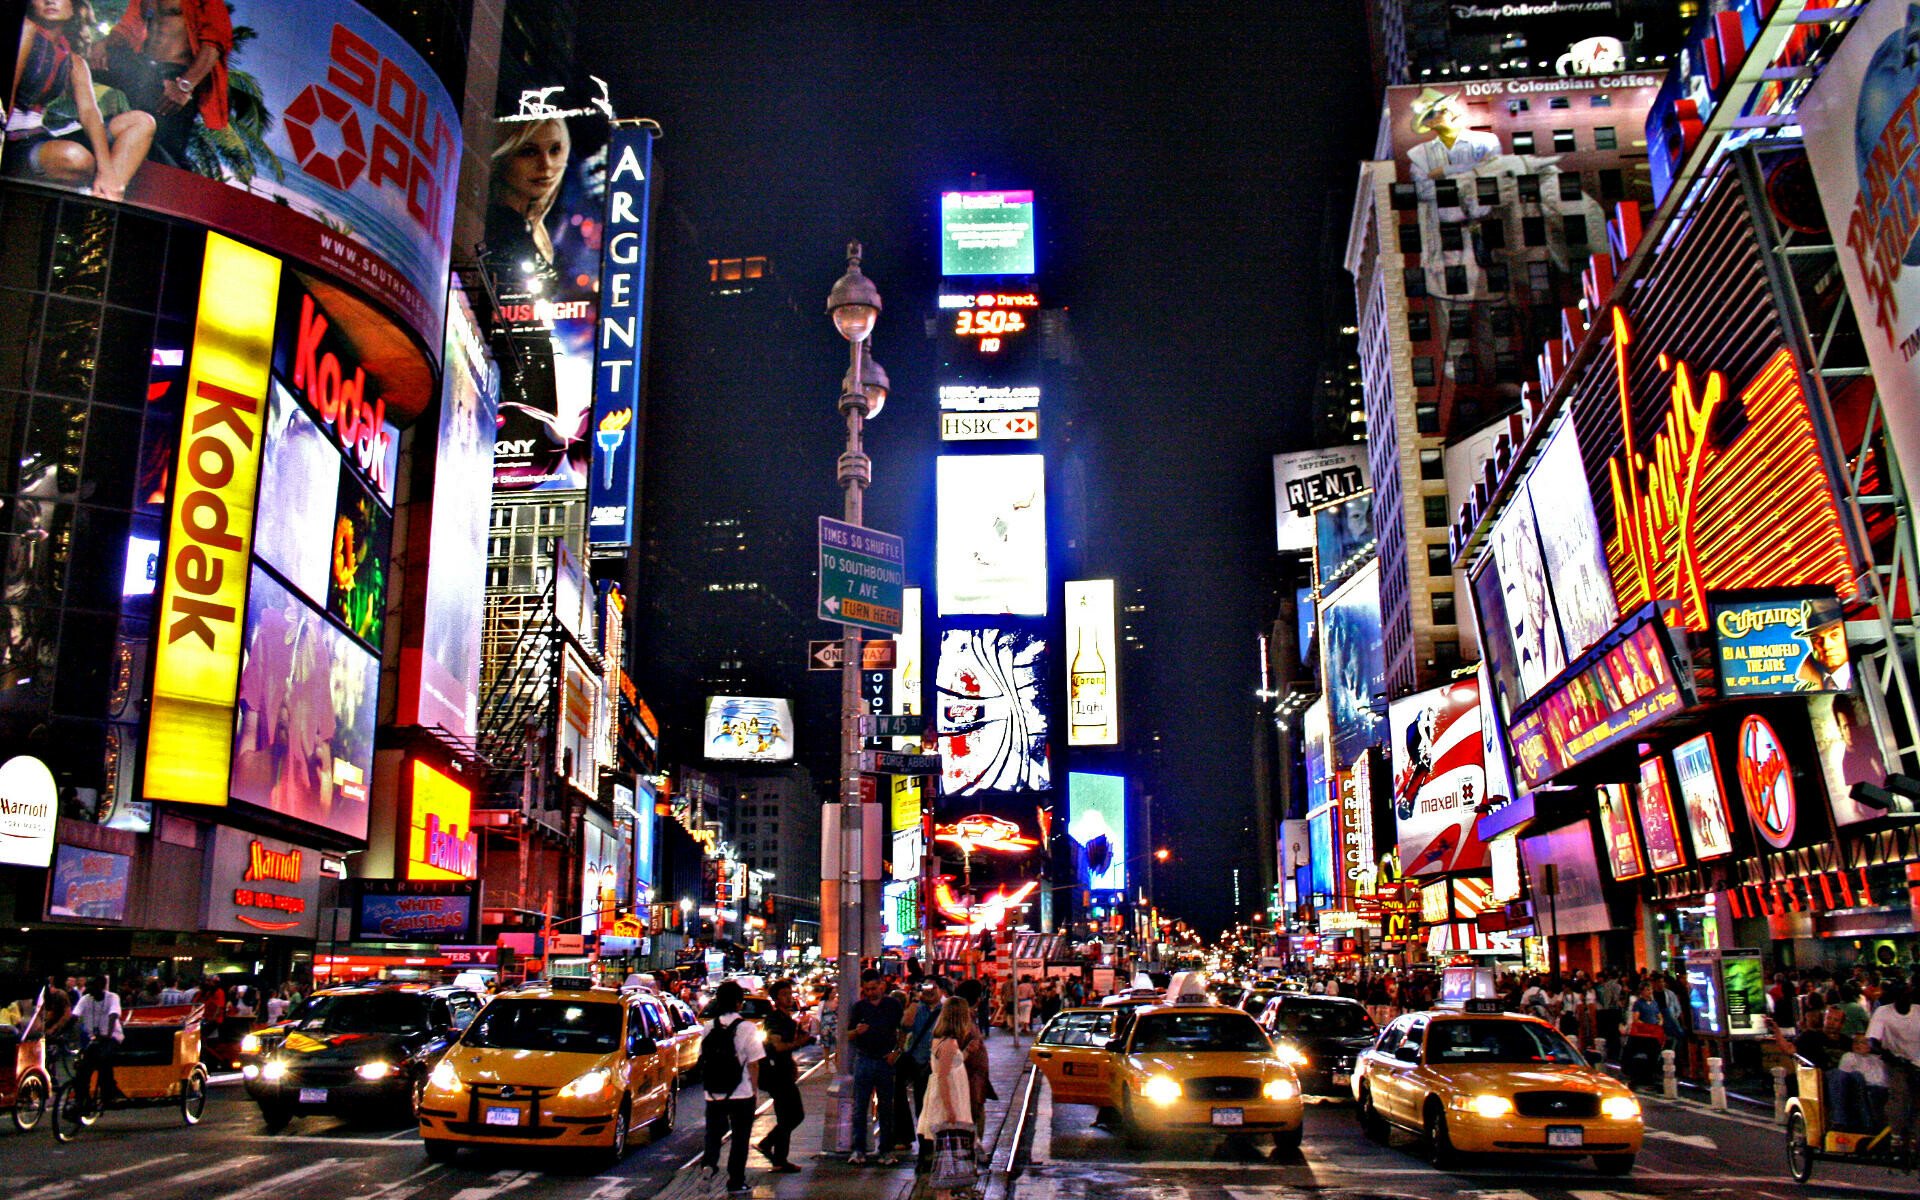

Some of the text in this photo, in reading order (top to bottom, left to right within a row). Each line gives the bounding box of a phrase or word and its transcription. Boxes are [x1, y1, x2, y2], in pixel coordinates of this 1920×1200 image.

[1465, 74, 1655, 96] 100% Colombian Coffee
[601, 145, 645, 393] ARGENT
[293, 293, 391, 493] Kodak
[1449, 201, 1639, 563] BERTELSMANN
[944, 418, 1000, 435] HSBC
[1288, 471, 1356, 504] RENT
[168, 380, 258, 652] Kodak
[824, 527, 848, 545] TIMES
[865, 538, 900, 559] SHUFFLE
[824, 554, 900, 584] TO SOUTHBOUND
[848, 580, 878, 599] 7 AVE
[843, 600, 899, 626] TURN HERE
[823, 649, 844, 661] ON
[1735, 646, 1748, 659] AL
[1745, 658, 1786, 673] THEATRE
[872, 673, 883, 744] OVOTL
[880, 718, 888, 733] W
[893, 718, 907, 734] 45
[877, 753, 905, 767] GEORGE
[1421, 791, 1458, 814] maxell
[243, 840, 303, 884] Marriott
[396, 898, 444, 914] WHITE
[380, 911, 463, 936] CHRISTMAS
